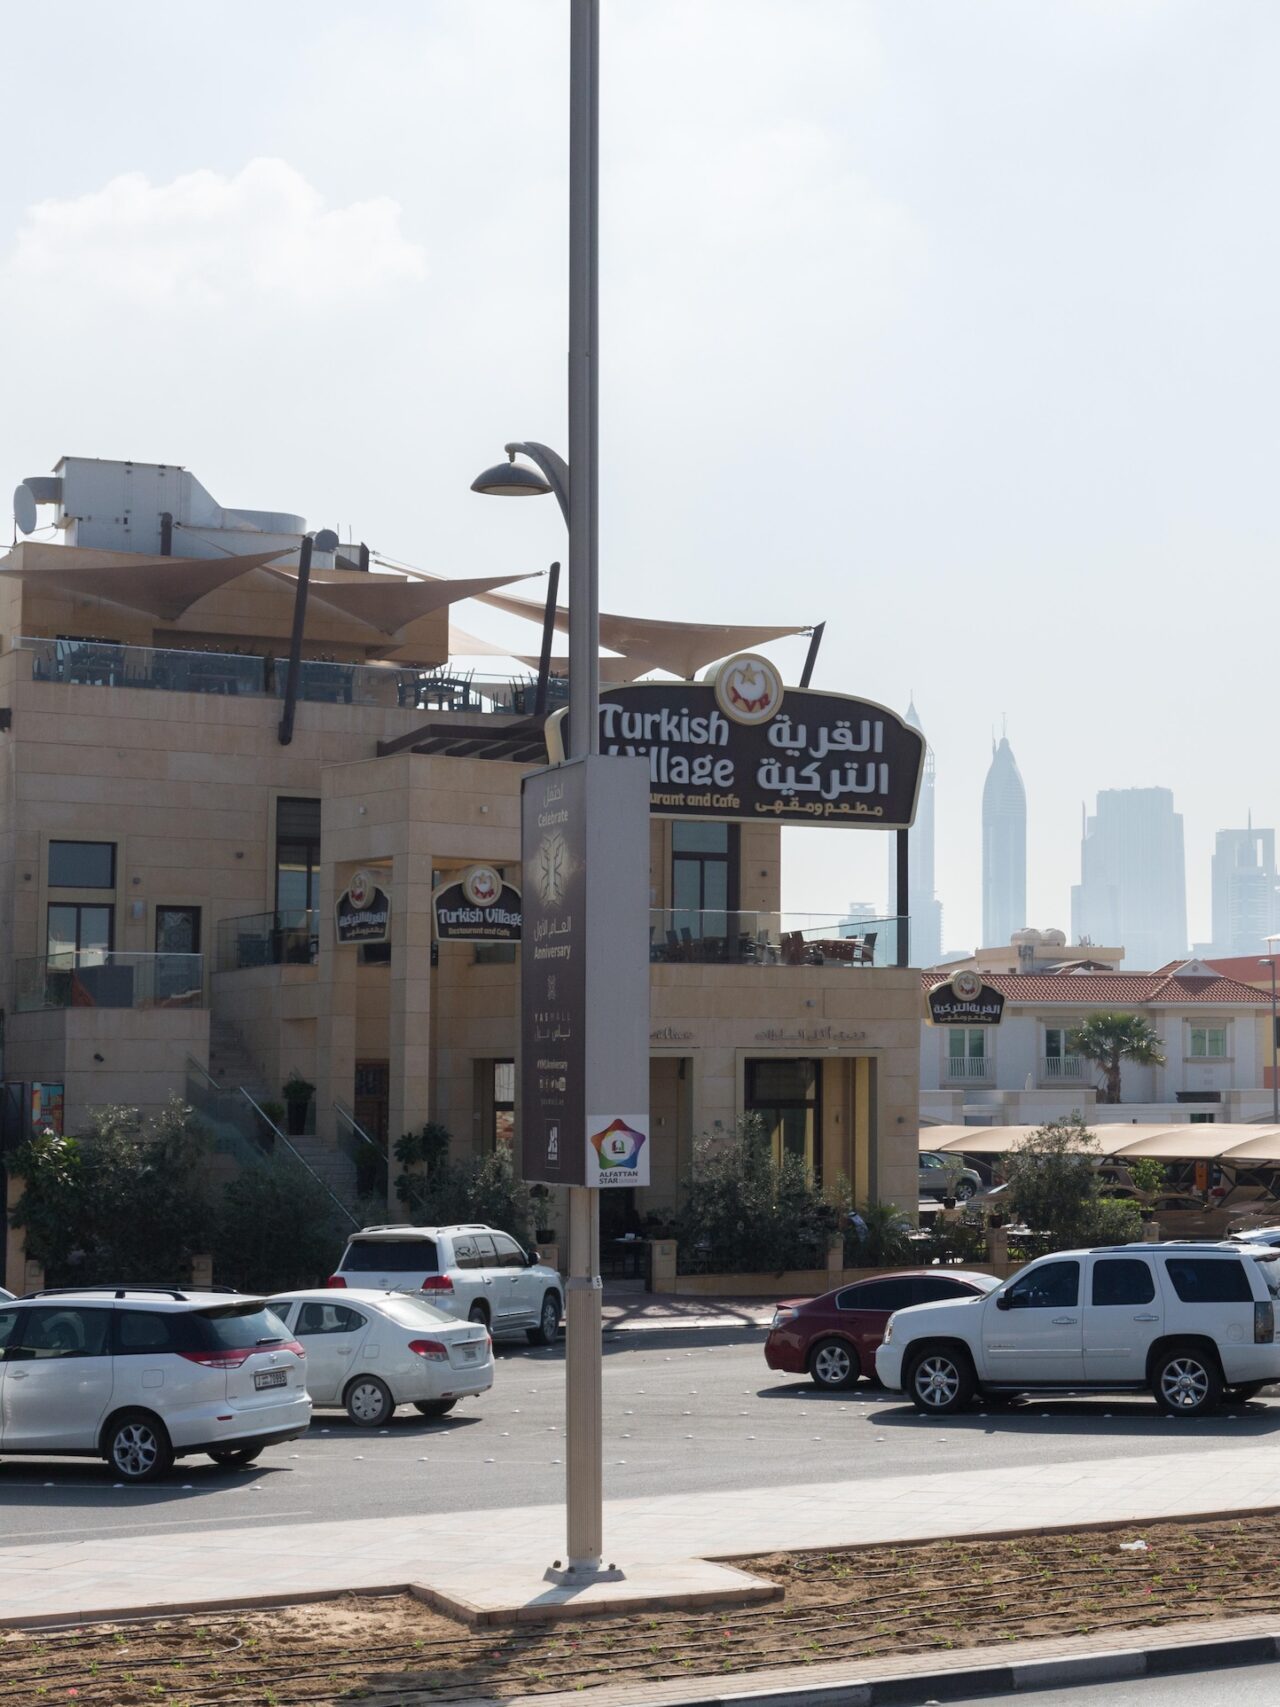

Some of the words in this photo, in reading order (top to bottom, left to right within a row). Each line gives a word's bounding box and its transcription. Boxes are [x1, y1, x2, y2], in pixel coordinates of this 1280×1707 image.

[599, 703, 729, 746] Turkish
[768, 714, 883, 758] القرية
[608, 745, 734, 788] llage
[757, 757, 889, 800] التركية
[687, 793, 711, 806] and
[713, 794, 740, 808] Cafe
[538, 809, 569, 828] Celebrate
[438, 907, 483, 923] Turkish
[485, 908, 522, 927] Village
[448, 927, 483, 936] Restaurant
[484, 927, 496, 935] and
[534, 943, 573, 961] Anniversary
[599, 1177, 618, 1185] STAR
